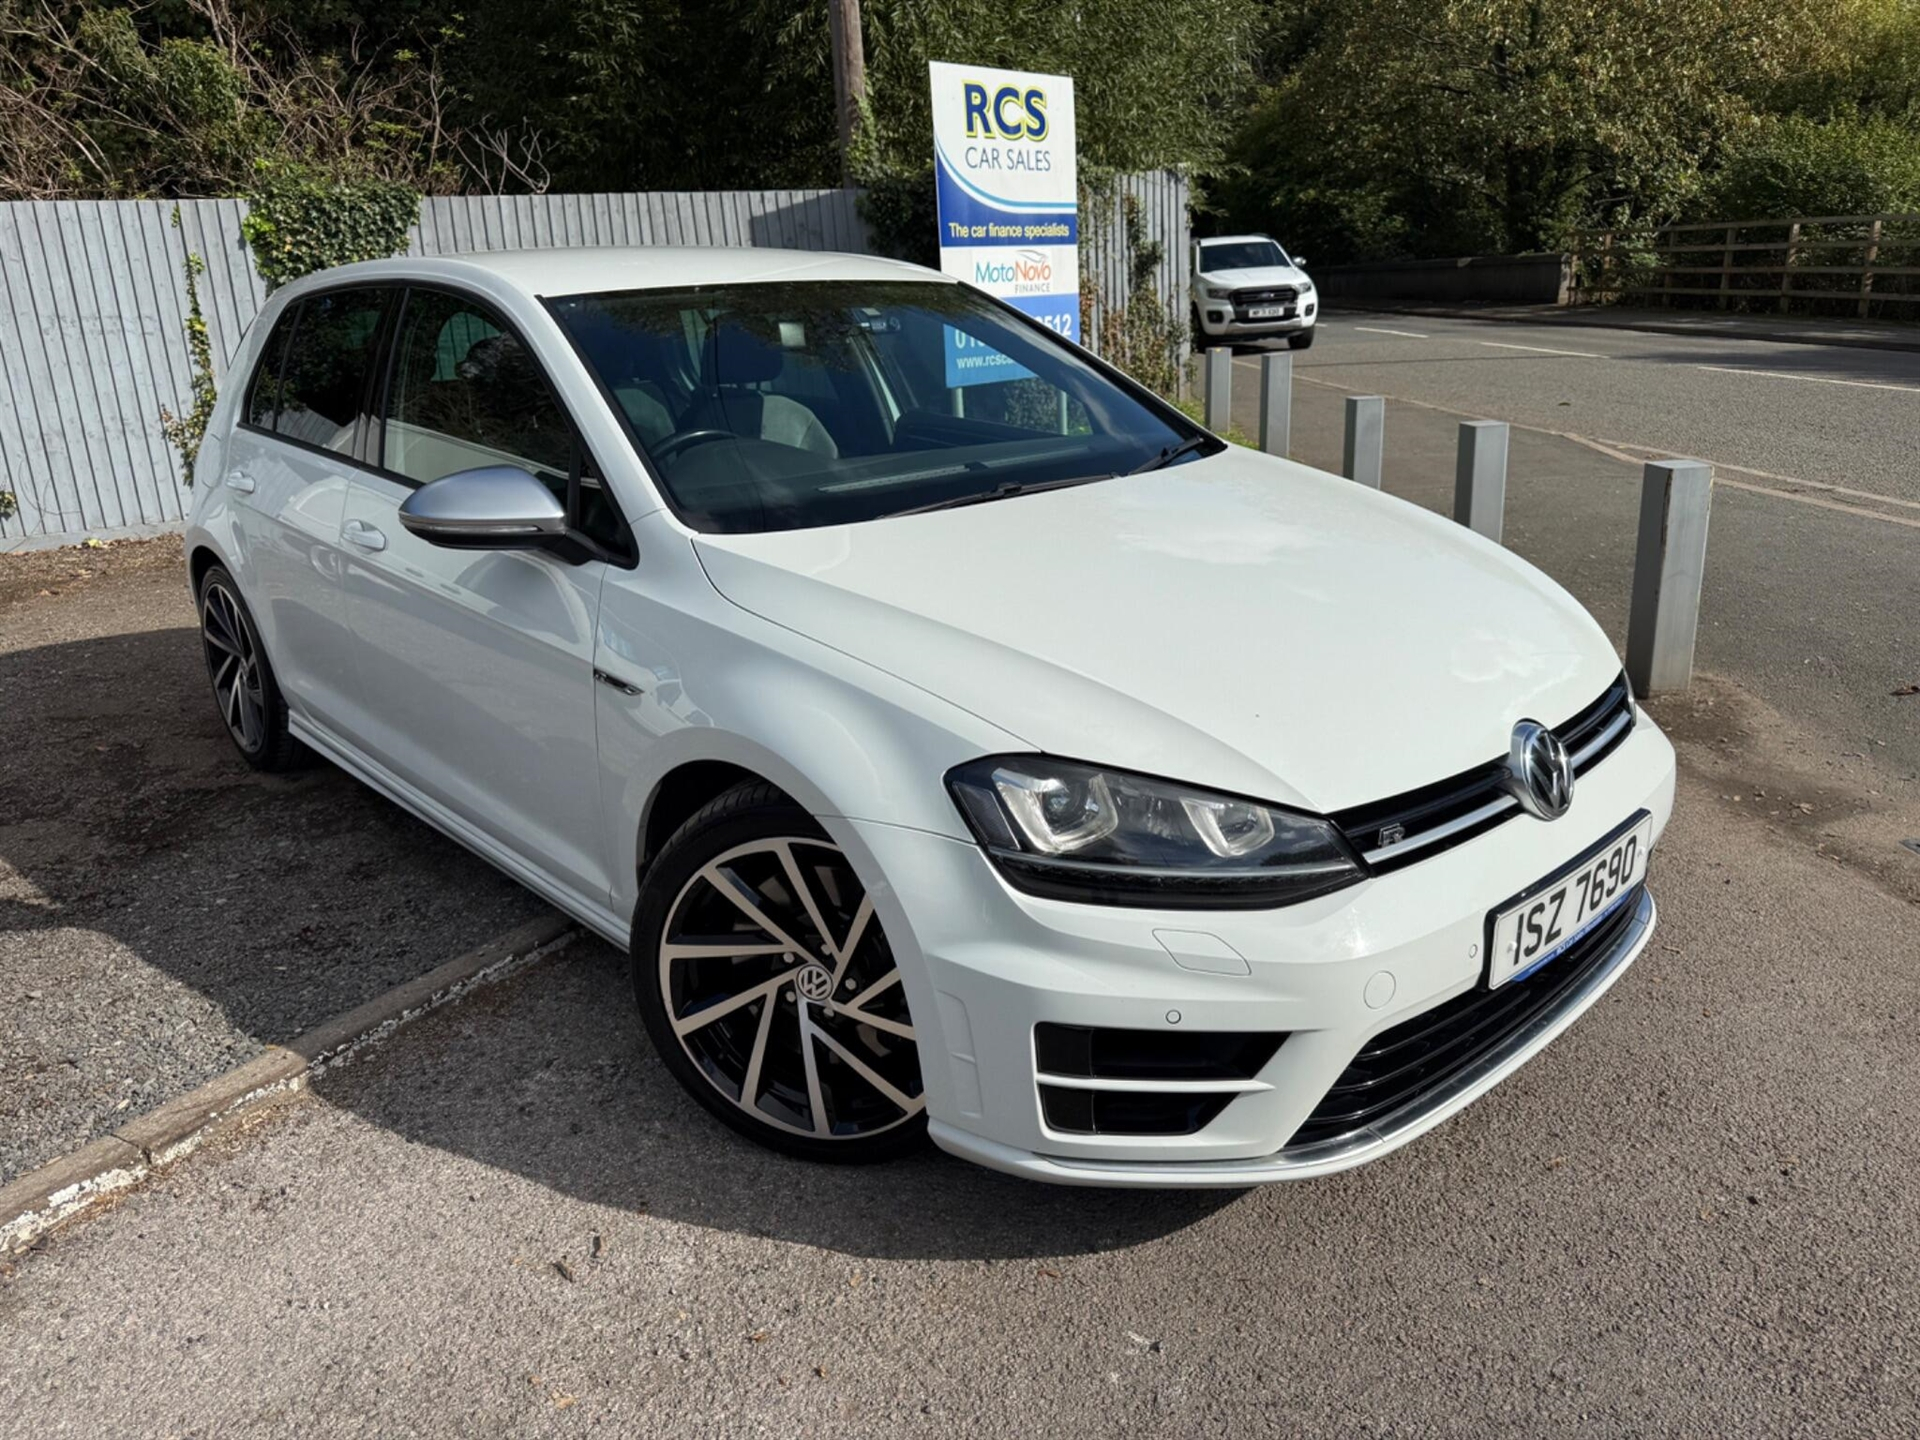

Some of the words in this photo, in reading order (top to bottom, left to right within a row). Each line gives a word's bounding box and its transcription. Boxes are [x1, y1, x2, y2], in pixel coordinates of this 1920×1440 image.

[962, 80, 1049, 142] RCS
[965, 146, 1002, 169] CAR
[1007, 148, 1051, 171] SALES
[948, 222, 970, 238] The
[971, 226, 987, 238] car
[988, 222, 1023, 238] finance
[1024, 222, 1070, 240] specialists
[975, 260, 1052, 283] MotoNovo
[1015, 283, 1051, 294] FINANCE
[1513, 886, 1567, 966] ISZ
[1576, 834, 1638, 925] 7690
